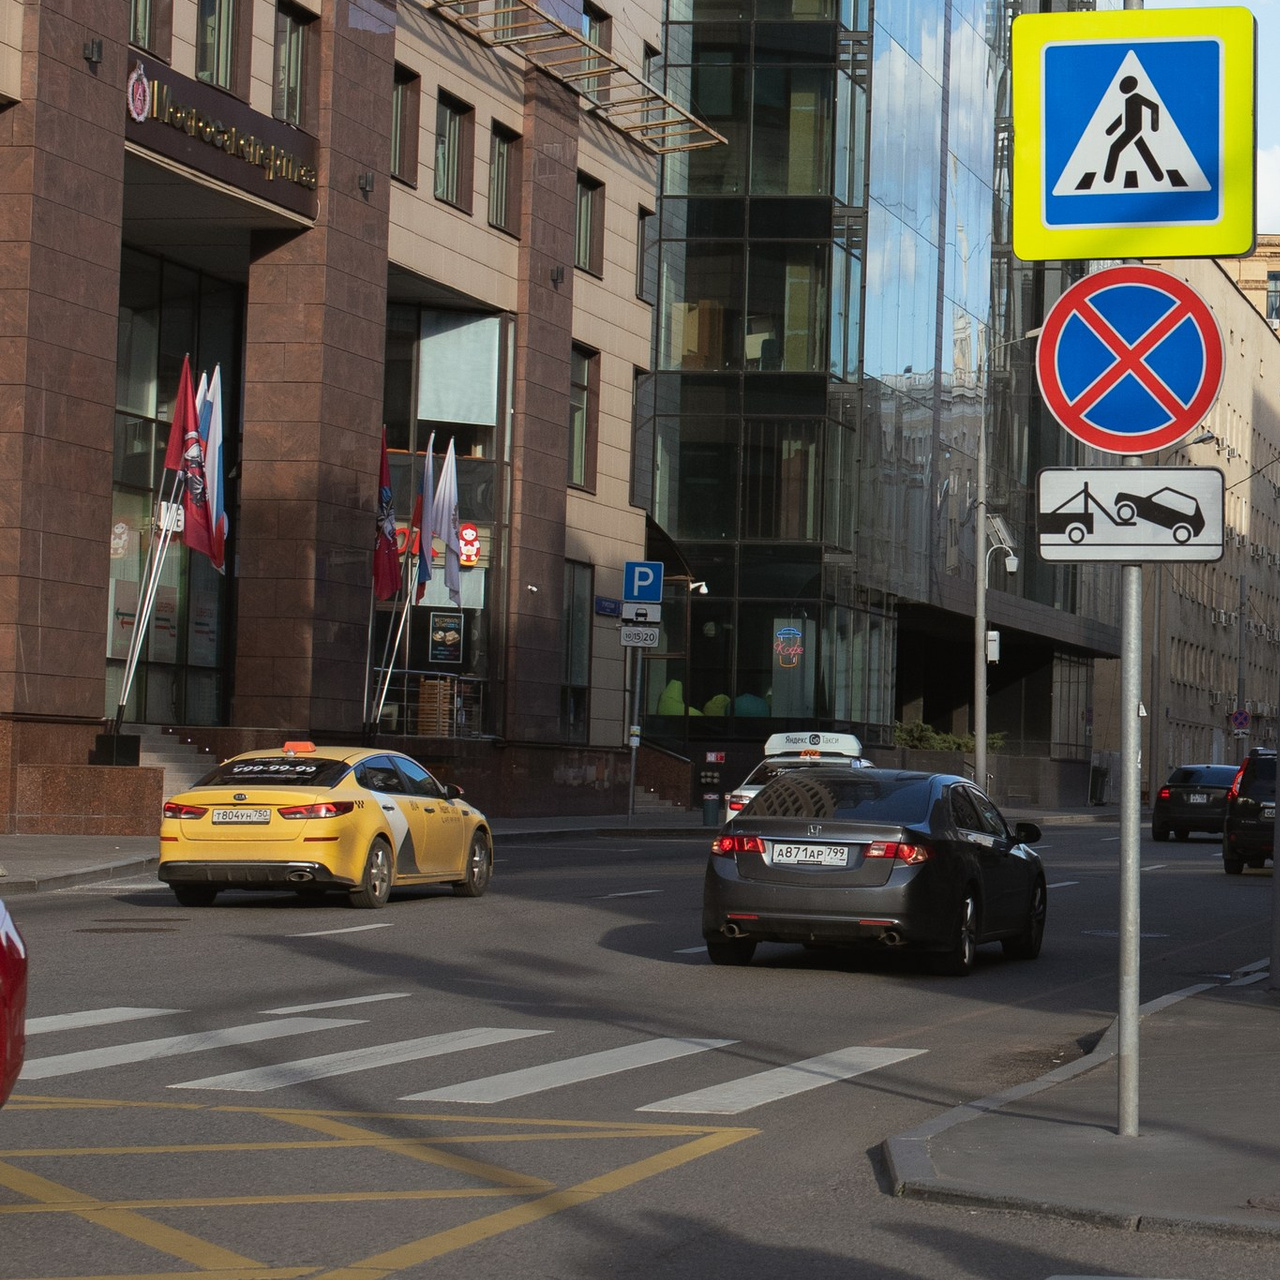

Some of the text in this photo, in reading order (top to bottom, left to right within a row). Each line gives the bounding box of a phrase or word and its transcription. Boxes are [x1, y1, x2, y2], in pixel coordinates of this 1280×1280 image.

[633, 566, 654, 596] P
[625, 632, 655, 641] 10 15 20
[773, 640, 804, 659] Кофе
[785, 734, 840, 744] Яндекс Go Такси
[216, 810, 268, 820] Т804УН 750
[777, 846, 824, 859] А871АР
[826, 847, 845, 858] 799
